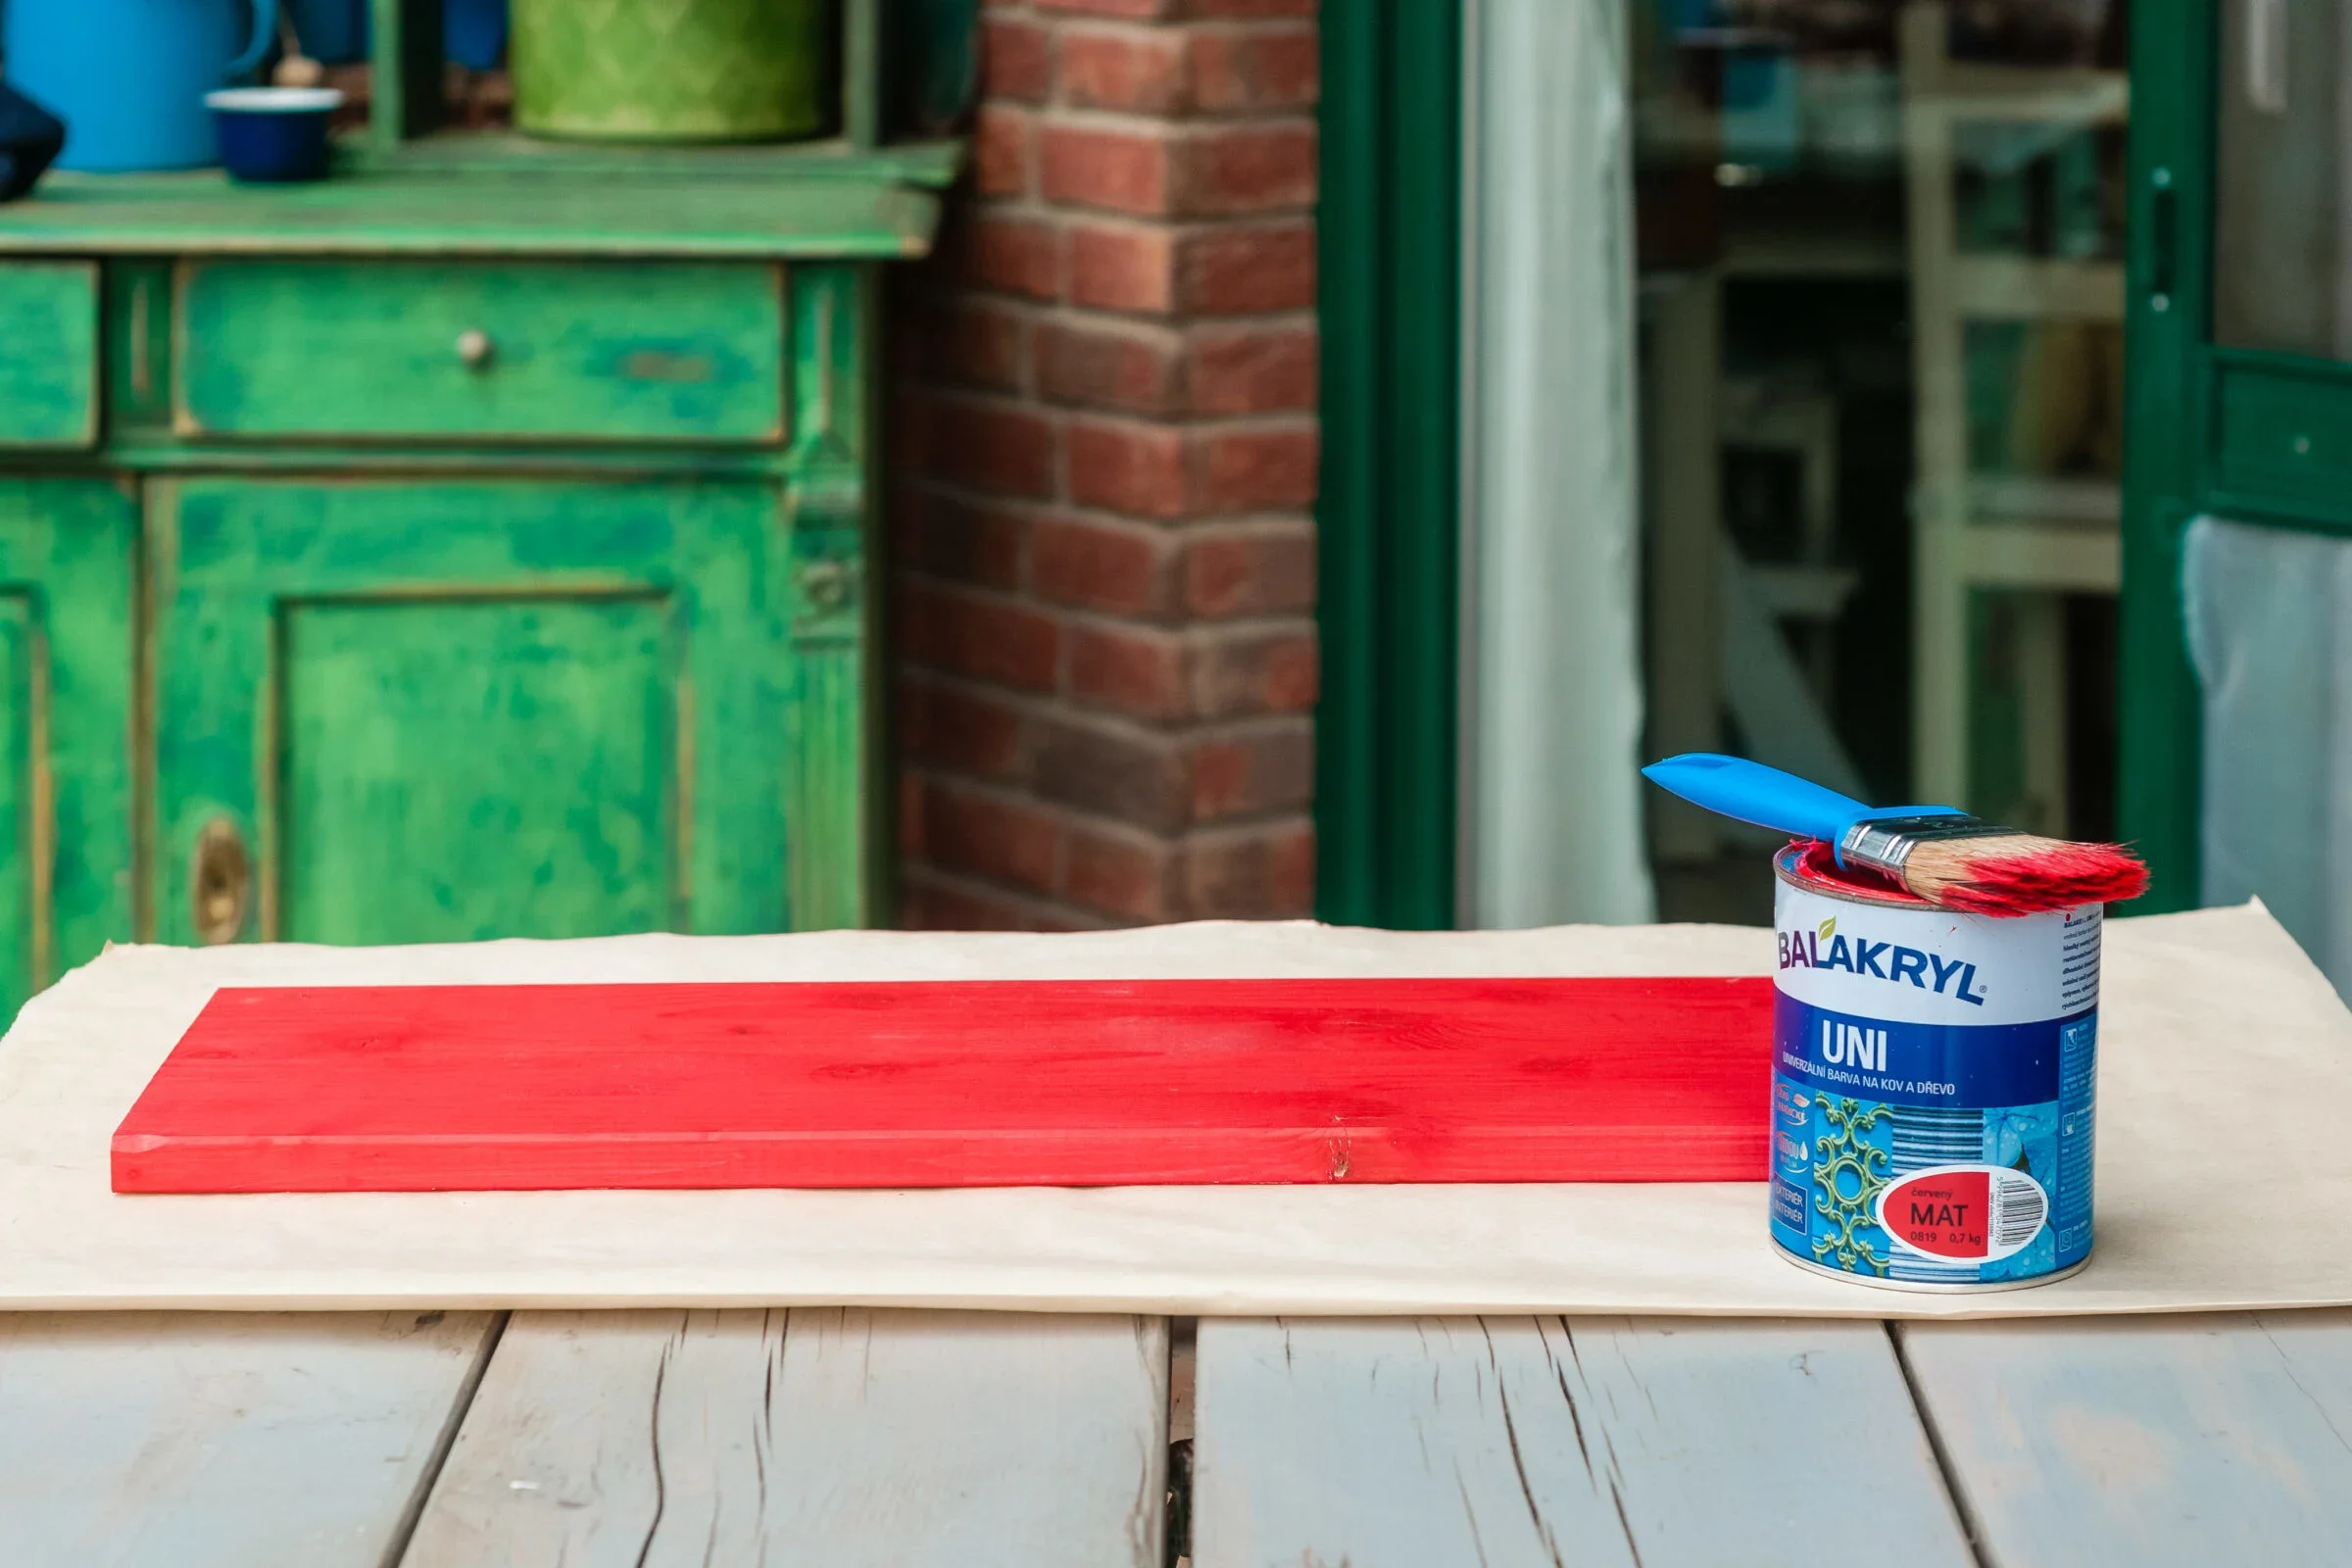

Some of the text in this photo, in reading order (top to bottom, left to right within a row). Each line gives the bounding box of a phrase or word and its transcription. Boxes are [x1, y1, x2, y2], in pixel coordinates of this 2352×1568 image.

[1823, 1019, 1886, 1072] UNI
[1783, 1052, 1955, 1096] UNIVERZÁLNÍ BARVA NA KOV A DŘEVO
[1911, 1187, 1953, 1200] červený
[1911, 1203, 1969, 1226] MAT
[1911, 1232, 1982, 1246] 0819 0,7 kg
